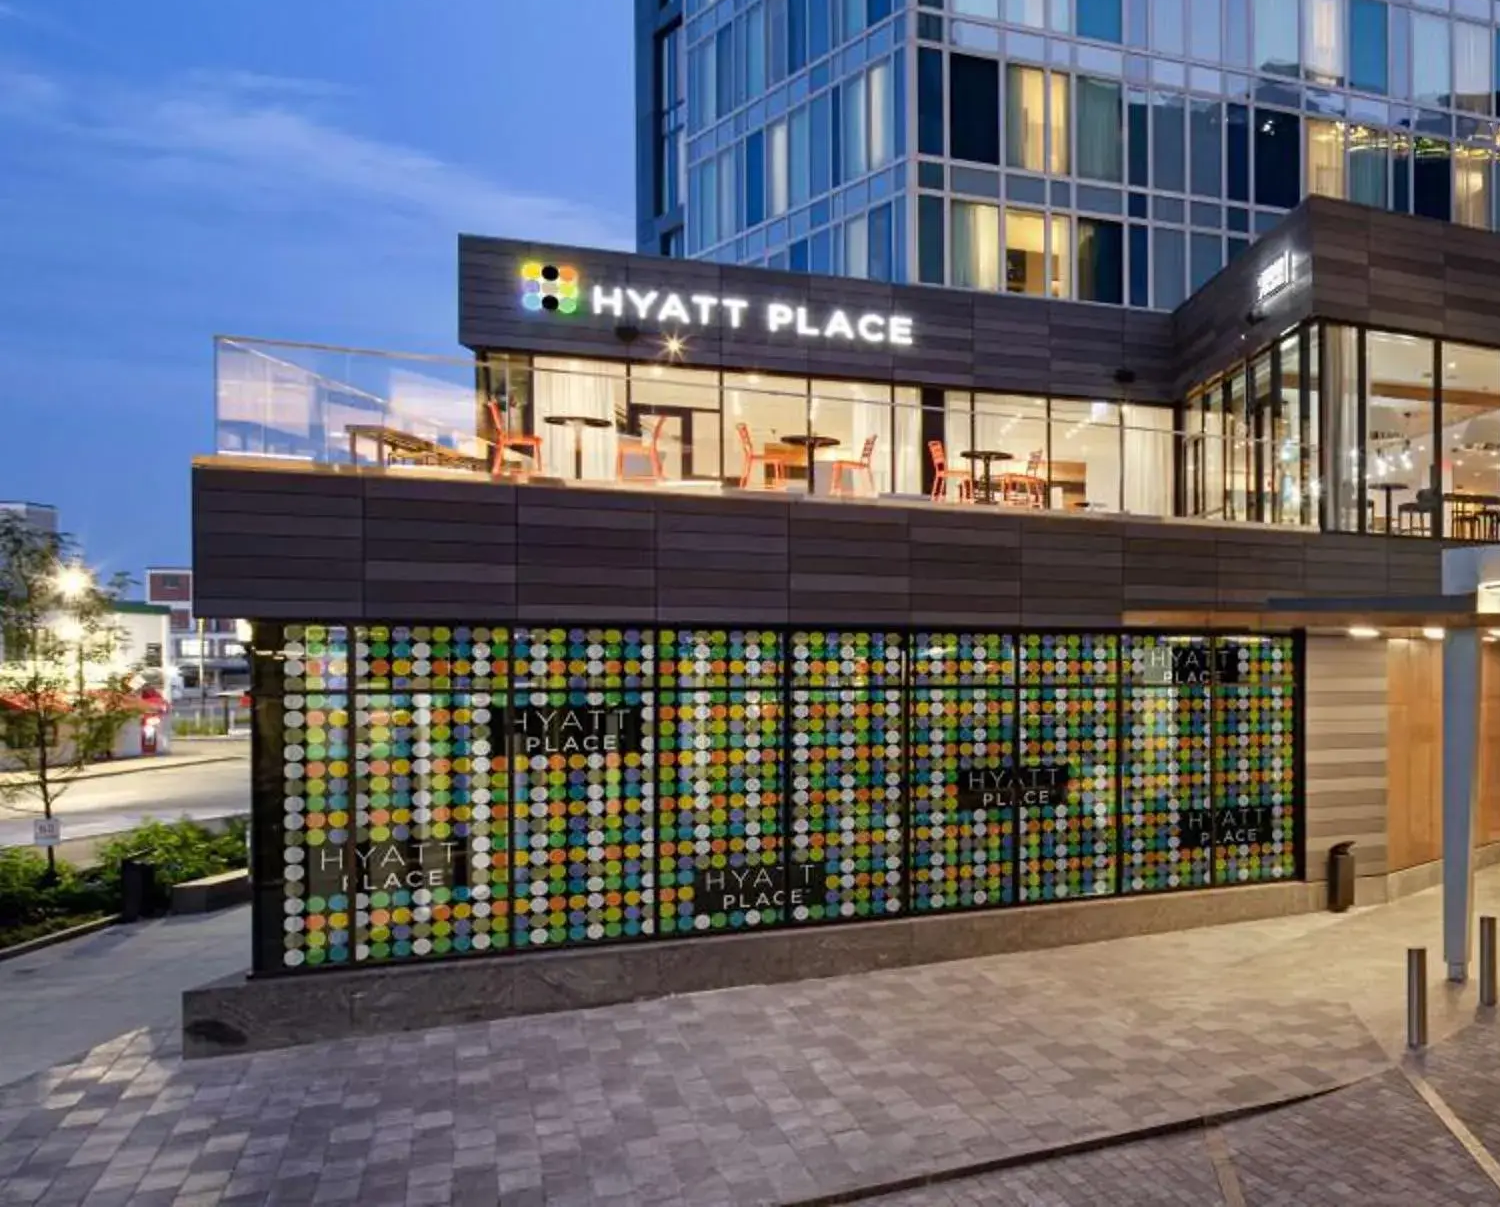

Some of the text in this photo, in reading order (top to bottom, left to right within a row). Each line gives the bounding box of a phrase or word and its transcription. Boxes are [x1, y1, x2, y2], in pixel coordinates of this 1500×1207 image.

[593, 285, 914, 345] HYATT PLACE
[513, 709, 630, 731] HYATT
[526, 735, 617, 753] PLACE
[983, 790, 1049, 807] PLCE
[1201, 828, 1257, 845] PACE
[320, 842, 459, 872] HYATT
[723, 888, 803, 910] PLACE
